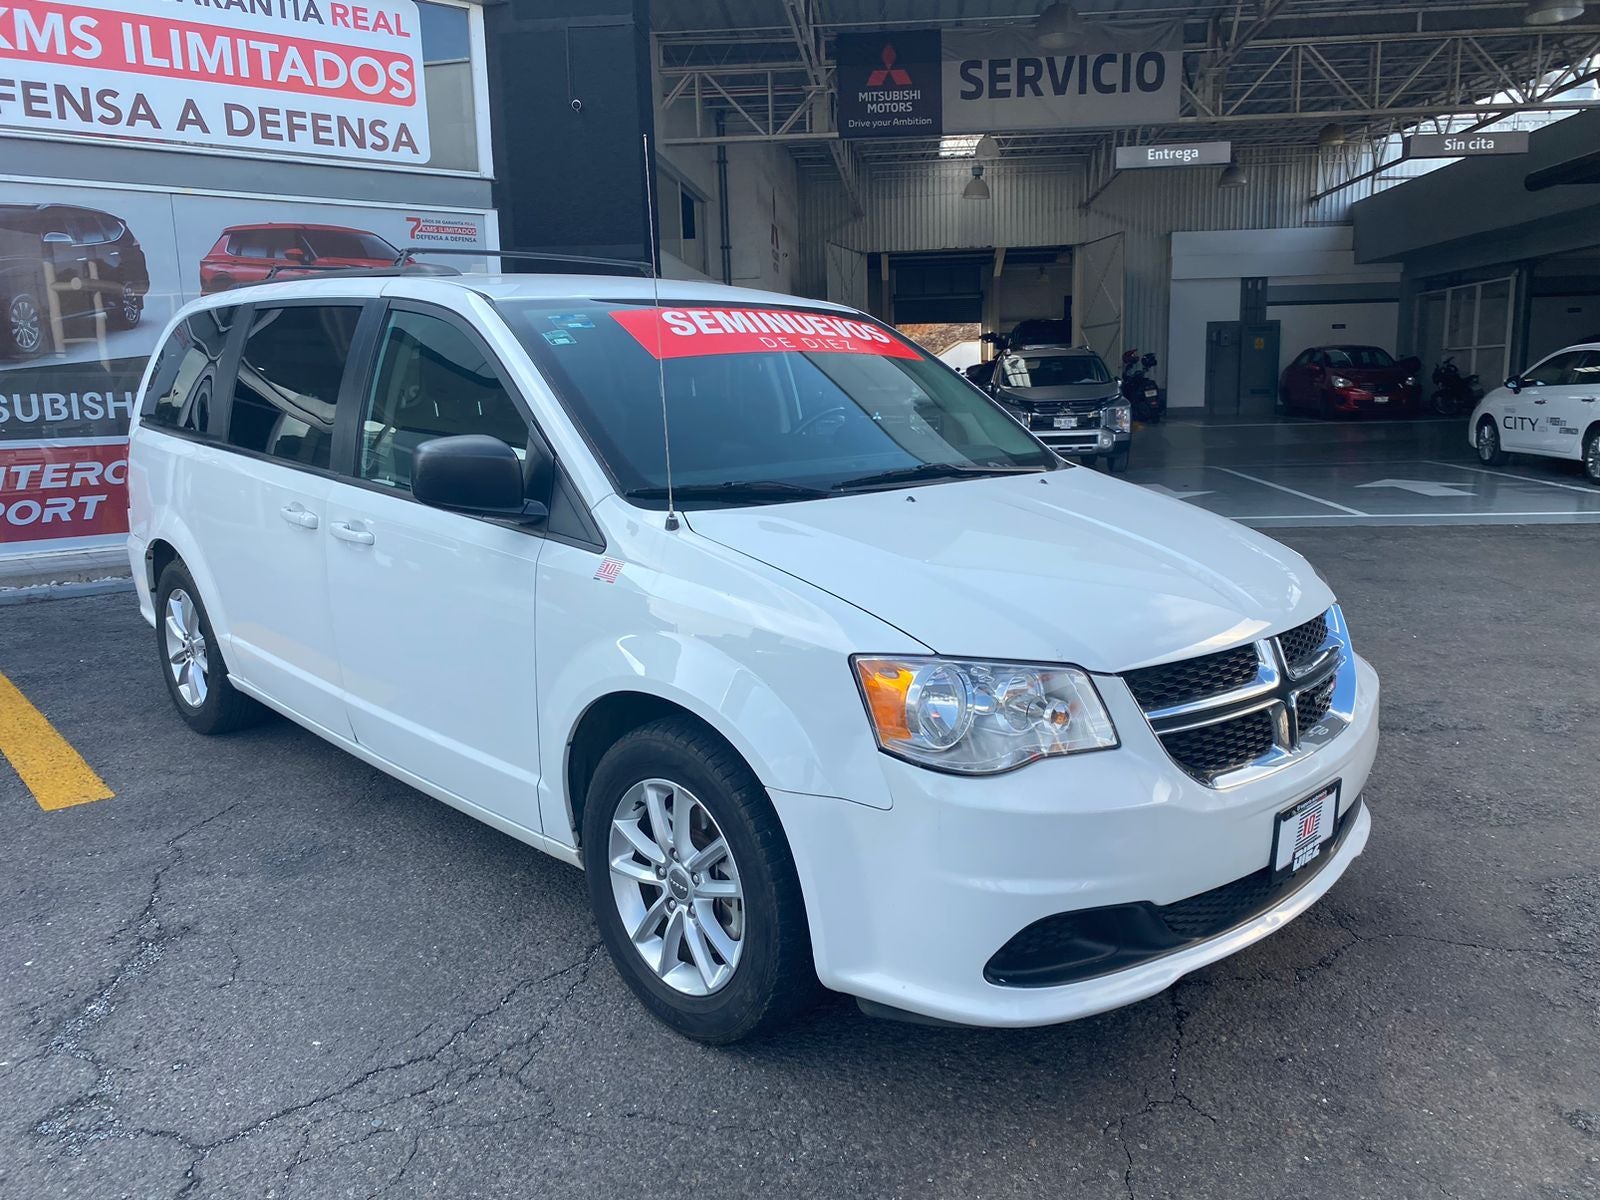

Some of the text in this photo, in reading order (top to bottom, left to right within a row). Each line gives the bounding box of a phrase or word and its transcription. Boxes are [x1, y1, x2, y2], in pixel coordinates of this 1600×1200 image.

[330, 2, 411, 38] REAL
[121, 22, 412, 99] ILIMITADOS
[959, 51, 1166, 100] SERVICIO
[858, 90, 921, 102] MITSUBISHI
[867, 102, 913, 113] MOTORS
[176, 98, 211, 134] A
[224, 102, 419, 155] DEFENSA
[848, 117, 933, 129] Drive your Ambition
[1444, 137, 1495, 151] Sin cita
[1147, 147, 1199, 162] Entrega
[405, 217, 421, 239] 7
[438, 226, 476, 235] ILIMITADOS
[661, 310, 891, 344] SEMINUEVOS
[759, 336, 857, 350] DE DIEZ
[0, 391, 138, 424] UBISH
[1503, 416, 1540, 431] CITY
[0, 494, 108, 526] ORT
